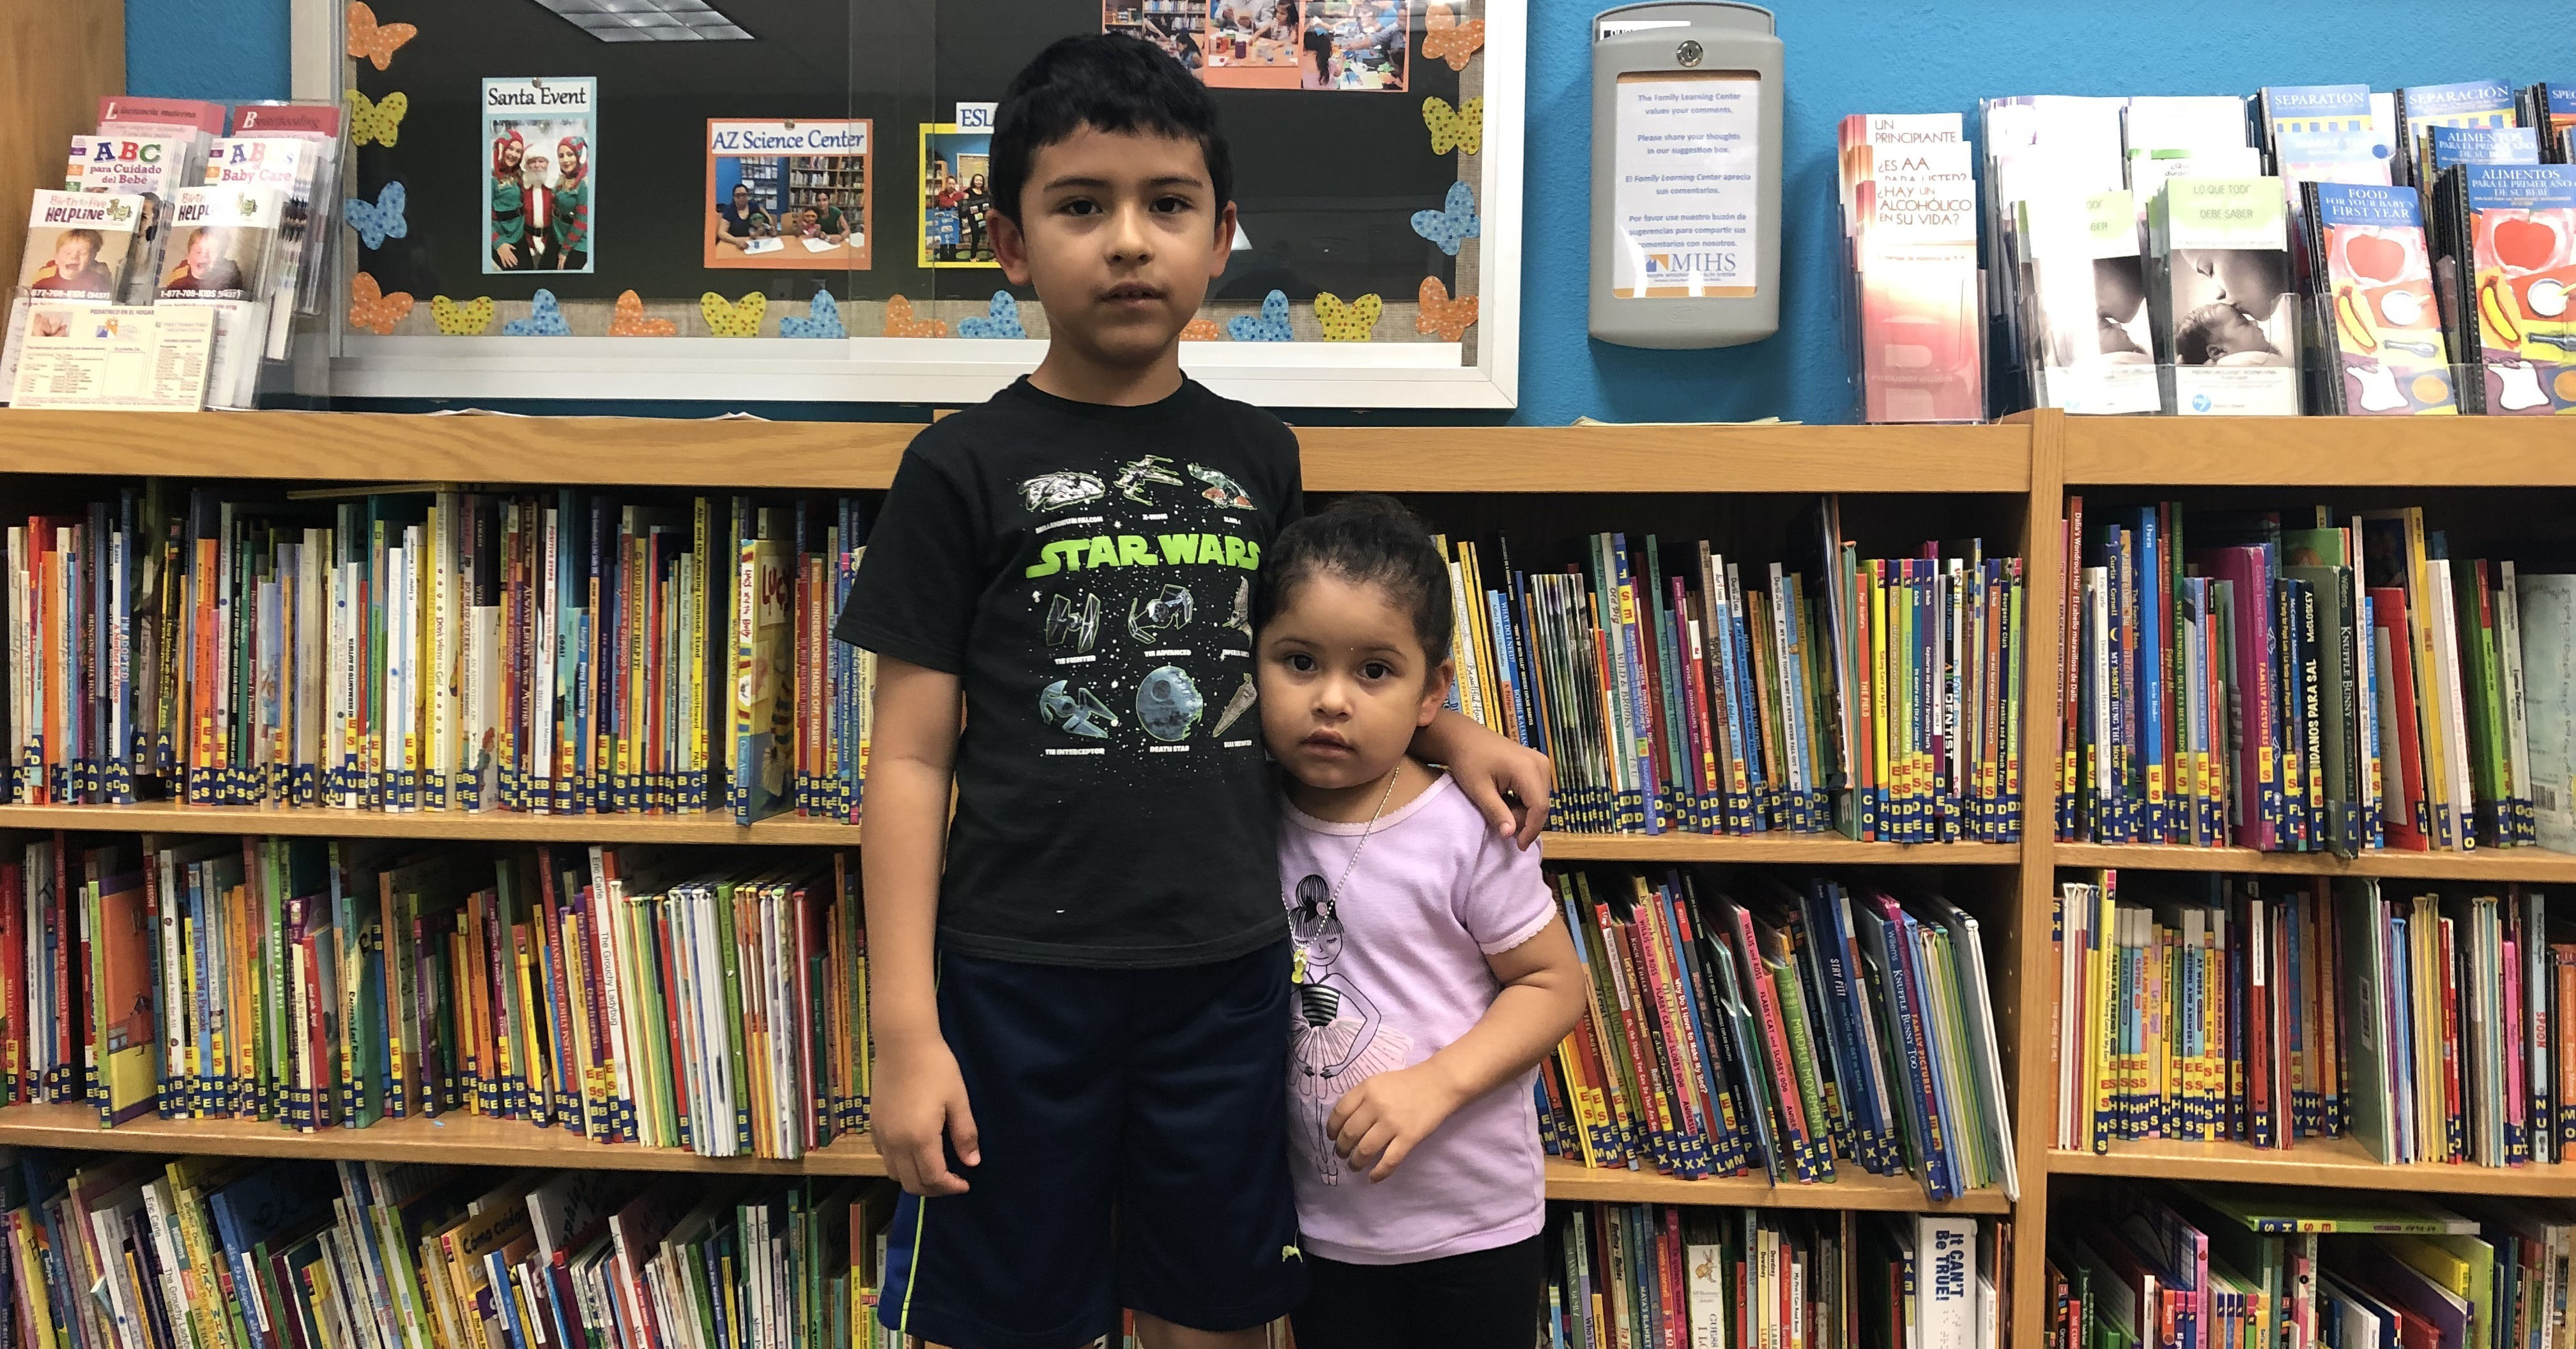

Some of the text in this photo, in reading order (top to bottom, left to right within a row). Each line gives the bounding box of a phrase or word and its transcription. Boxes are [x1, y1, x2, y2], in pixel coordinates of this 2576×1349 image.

[488, 88, 586, 107] Santa Event
[2275, 92, 2364, 105] SEPARATION
[961, 109, 994, 127] ESL
[1875, 119, 1894, 130] UN
[712, 130, 865, 150] AZ Science Center
[1876, 132, 1956, 143] PRINCIPIANTE
[94, 141, 161, 164] ABC
[90, 164, 162, 174] para Cuidado
[1878, 160, 1897, 172] ¿ES
[2481, 170, 2560, 179] ALIMENTOS
[222, 169, 291, 183] Baby Care
[2511, 179, 2547, 188] PRIMER
[1878, 187, 1914, 198] ¿HAY
[2348, 188, 2388, 199] FOOD
[1880, 197, 1972, 211] ALCOHÓLICO
[2333, 206, 2410, 218] FIRST YEAR
[2348, 199, 2376, 207] YOUR
[1880, 213, 1959, 225] EN SU VIDA?
[2224, 210, 2253, 219] SABER
[1629, 228, 1673, 236] sugerencias
[1695, 227, 1731, 235] compartir
[1671, 253, 1736, 271] MIHS
[1026, 533, 1261, 578] STAR WARS
[694, 560, 703, 592] Amazing
[2304, 591, 2315, 642] McCLOSKEY
[2340, 626, 2353, 717] KNUFFLE BUNNY
[811, 668, 820, 696] HANDS
[2305, 659, 2317, 718] PARA SAL
[2258, 662, 2269, 745] FAMILY PICTURES
[811, 719, 820, 748] HARRY!
[1945, 693, 1953, 759] DENTIST
[1997, 770, 2005, 786] Fairy
[592, 857, 604, 899] Eric Carle
[273, 929, 282, 959] WANT
[601, 931, 620, 1026] The Grouchy Ladybug
[1674, 979, 1683, 994] Why
[1830, 959, 1846, 996] STAY FIT!
[275, 973, 284, 1009] PARTY!
[1678, 995, 1686, 1005] Do
[1682, 1012, 1690, 1030] Have
[1892, 970, 1919, 1069] KNUFFLE BUNNY TOO
[2536, 1011, 2547, 1049] SPOON
[1689, 1042, 1699, 1060] Make
[1692, 1062, 1701, 1076] My
[1696, 1078, 1708, 1094] Bed?
[1793, 1019, 1823, 1138] MINDFUL MOVEMENTS
[1935, 1230, 1950, 1301] Be TRUE!
[1949, 1233, 1964, 1298] It CAN'T
